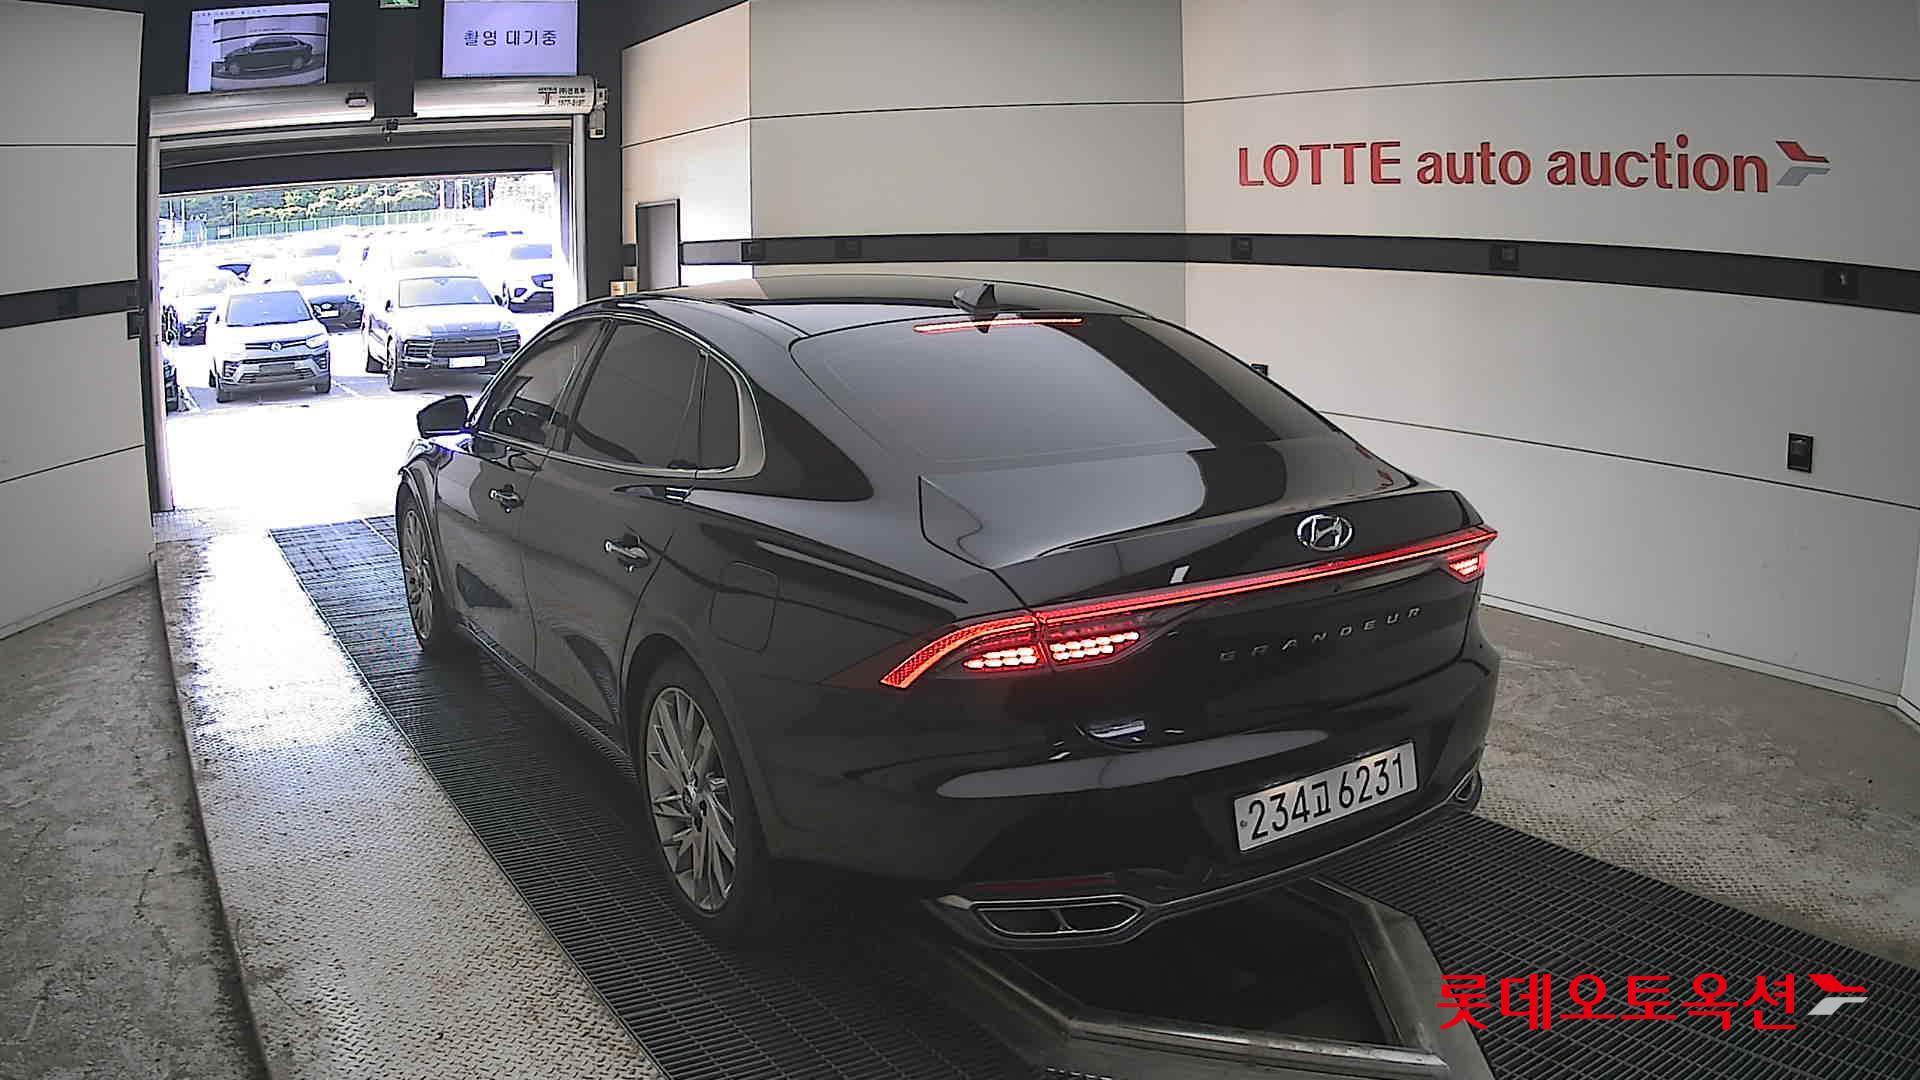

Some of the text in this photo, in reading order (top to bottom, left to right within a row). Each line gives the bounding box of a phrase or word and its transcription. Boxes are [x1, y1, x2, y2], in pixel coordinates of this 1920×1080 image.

[505, 30, 557, 46] 대기중
[1238, 134, 1769, 193] LOTTE auto auction
[1219, 607, 1420, 661] GRANDEUR
